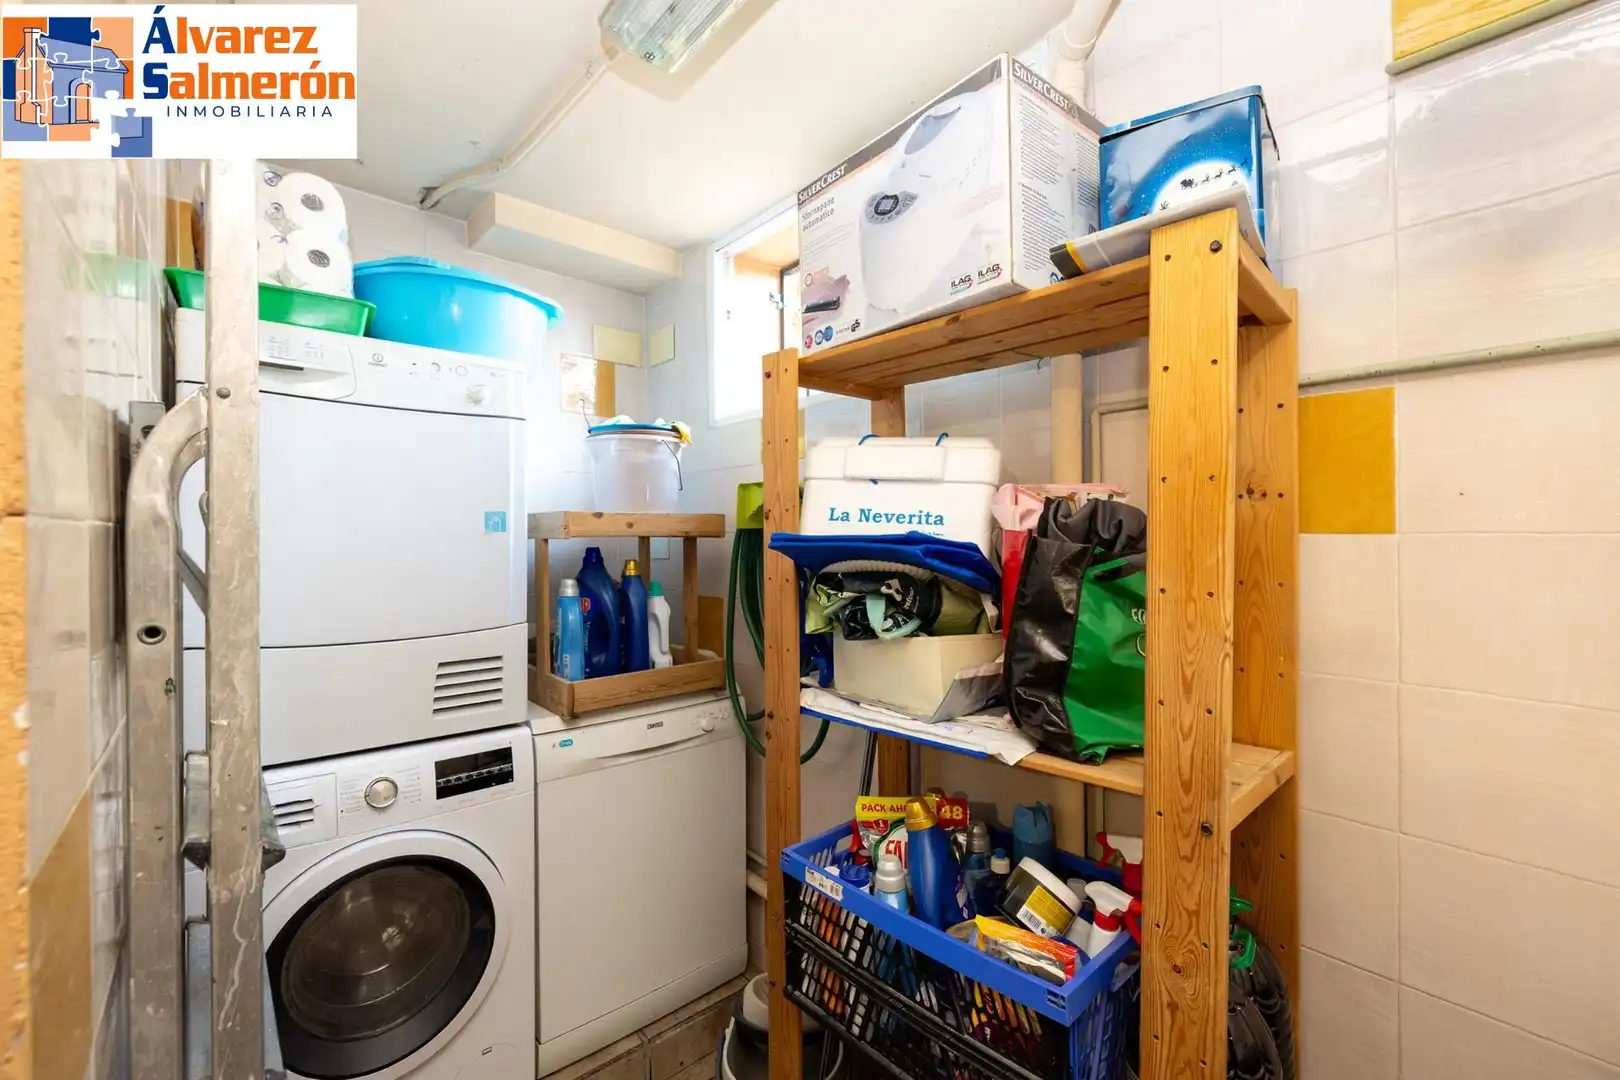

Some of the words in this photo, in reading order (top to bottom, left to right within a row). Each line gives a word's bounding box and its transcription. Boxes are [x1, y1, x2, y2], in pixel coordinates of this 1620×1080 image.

[1013, 62, 1070, 110] SILVERCREST
[798, 163, 847, 204] SILVERCREST
[977, 263, 1000, 278] ILAG
[950, 274, 972, 288] ILAG
[828, 507, 850, 523] La
[858, 508, 945, 526] Neverita
[861, 804, 886, 813] PACK
[941, 805, 963, 820] 48
